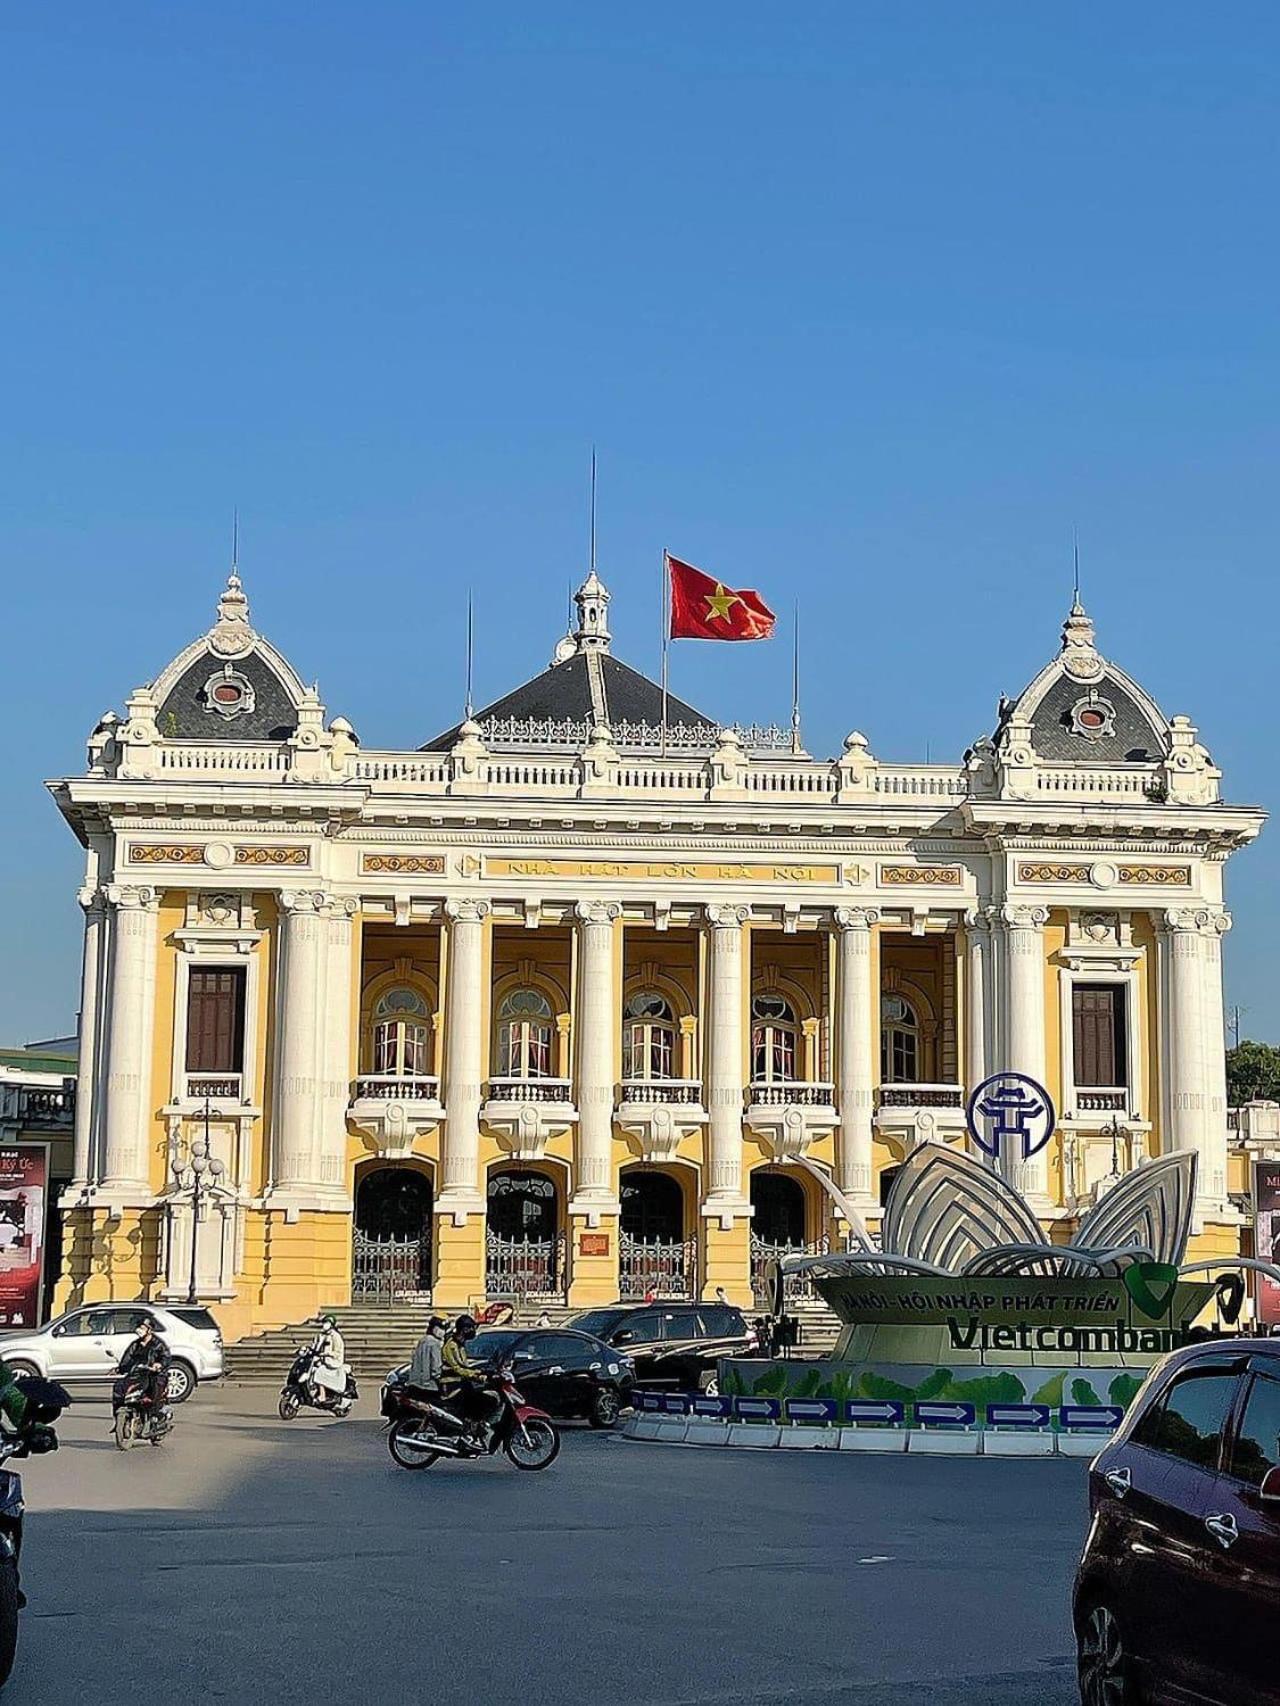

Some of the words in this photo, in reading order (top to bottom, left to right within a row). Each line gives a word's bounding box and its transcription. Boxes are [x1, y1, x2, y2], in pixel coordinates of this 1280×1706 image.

[508, 860, 559, 875] NHÀ
[578, 863, 629, 877] HÁT
[718, 864, 752, 879] HÀ
[936, 1291, 995, 1312] NHẬP
[1002, 1290, 1058, 1310] PHÁT
[1063, 1289, 1119, 1311] TRIỂN
